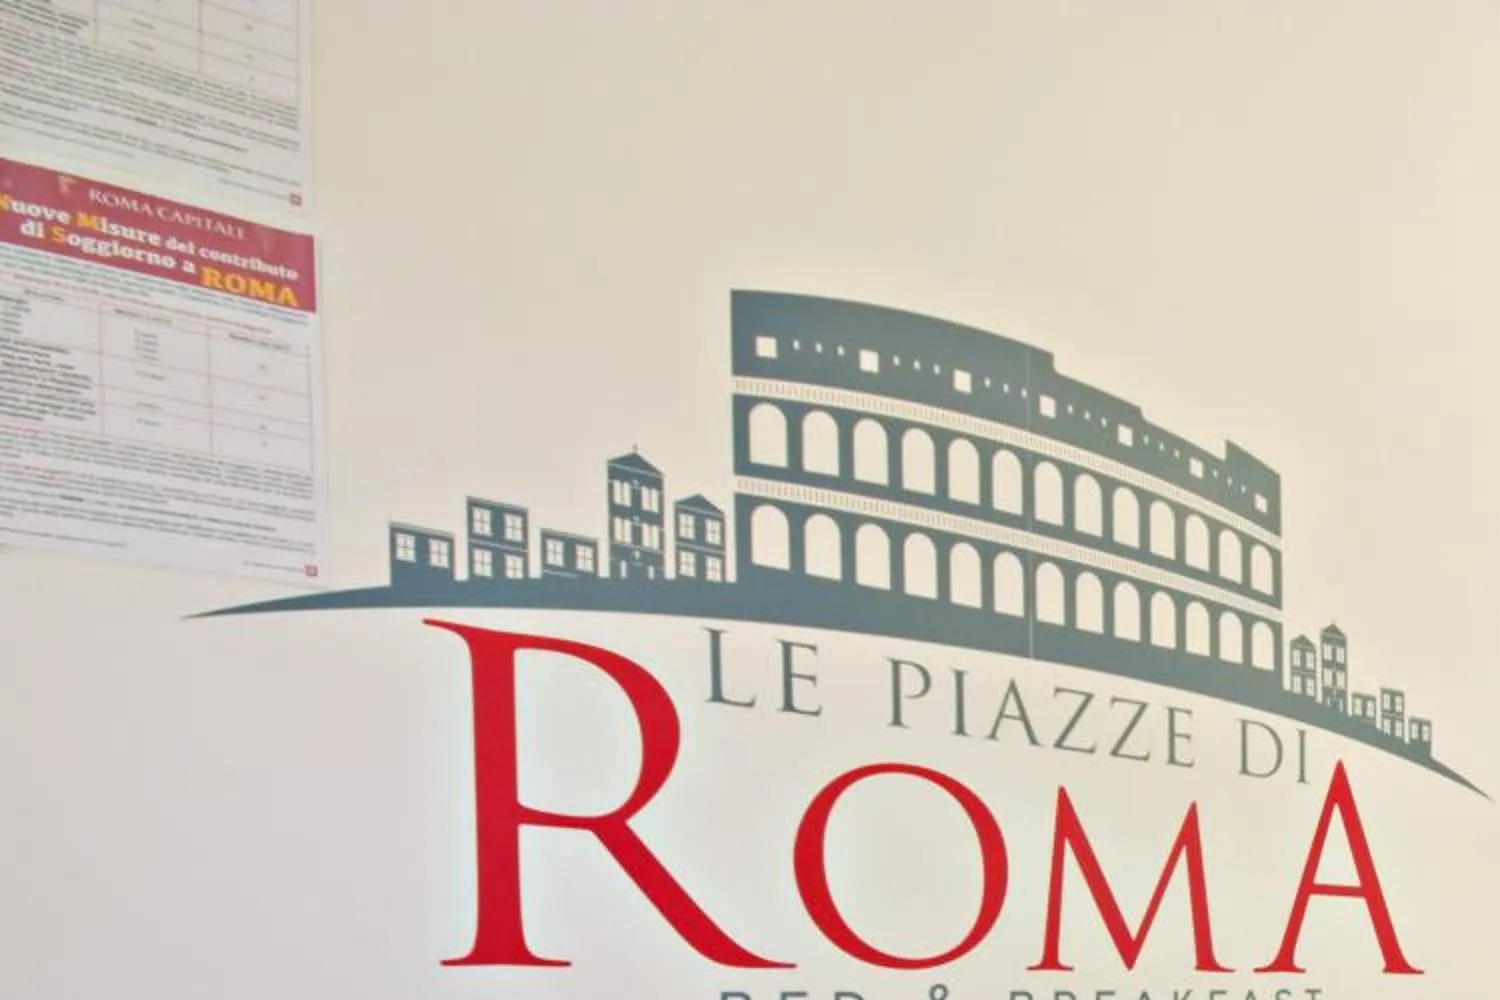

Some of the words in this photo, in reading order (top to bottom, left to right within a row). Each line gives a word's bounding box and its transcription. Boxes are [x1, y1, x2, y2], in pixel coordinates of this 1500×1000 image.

[20, 219, 45, 239] di
[182, 259, 197, 274] a
[201, 265, 299, 307] ROMA
[89, 187, 153, 217] ROMA
[704, 627, 823, 718] LE
[884, 656, 1197, 768] PIAZZE
[1238, 718, 1312, 785] DI
[423, 619, 1424, 976] ROMA
